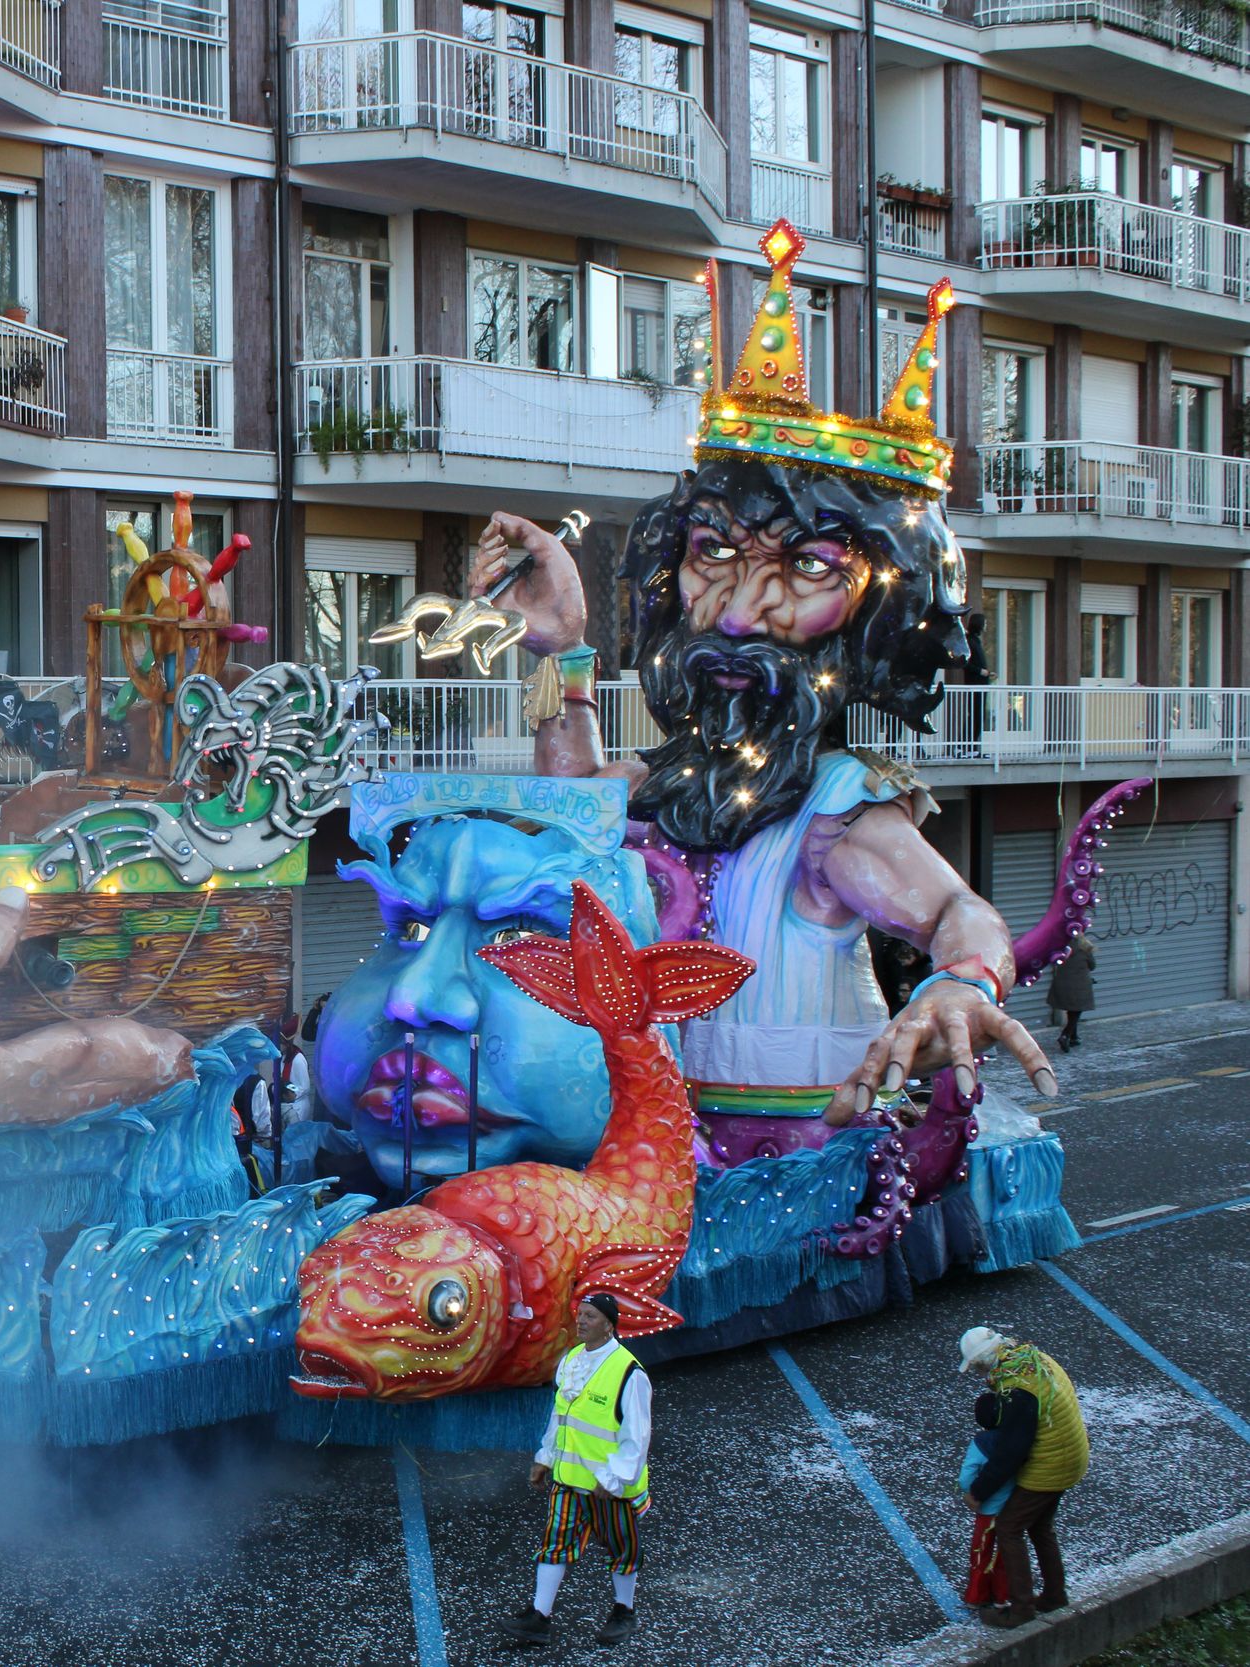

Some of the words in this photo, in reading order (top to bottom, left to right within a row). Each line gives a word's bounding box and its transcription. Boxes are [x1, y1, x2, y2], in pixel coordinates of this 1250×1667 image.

[363, 775, 419, 814] EOLO
[479, 776, 509, 803] del
[517, 778, 601, 825] VENTO
